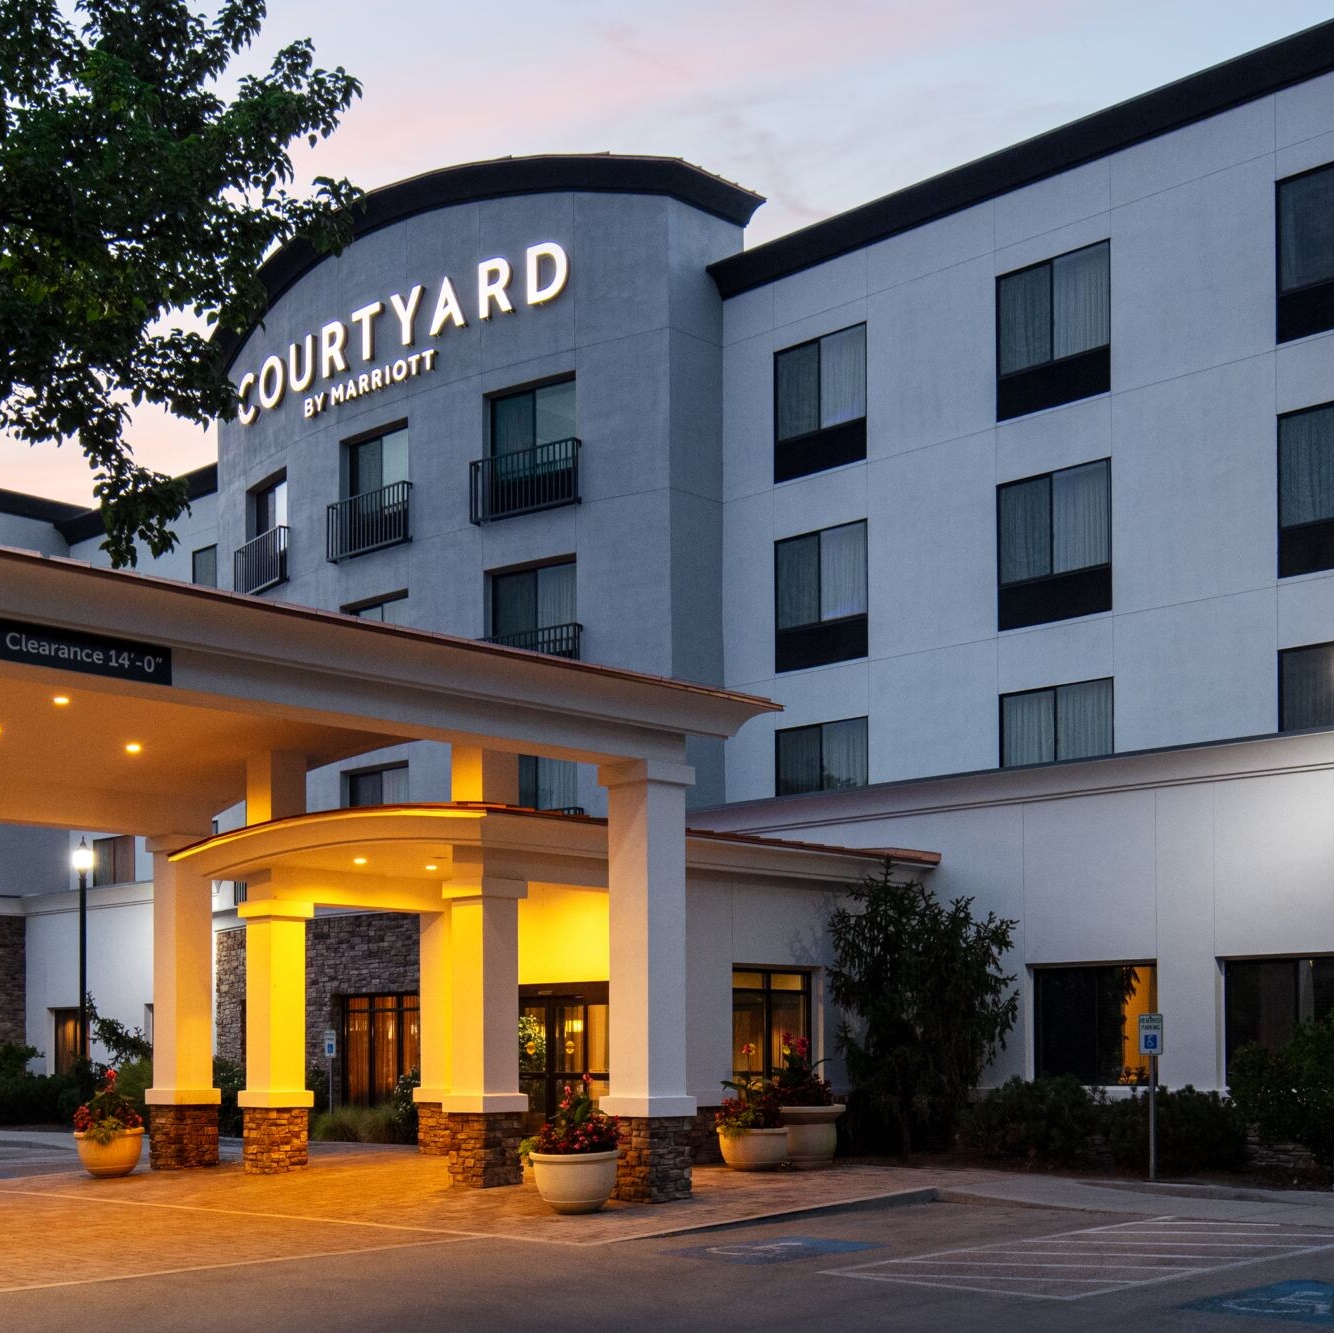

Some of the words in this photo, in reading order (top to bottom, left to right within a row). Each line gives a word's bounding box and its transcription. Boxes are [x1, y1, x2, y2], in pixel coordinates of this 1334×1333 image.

[238, 242, 568, 425] COURTYARD
[304, 392, 324, 418] BY
[331, 349, 435, 406] MARRIOTT
[5, 632, 104, 664] Clearance
